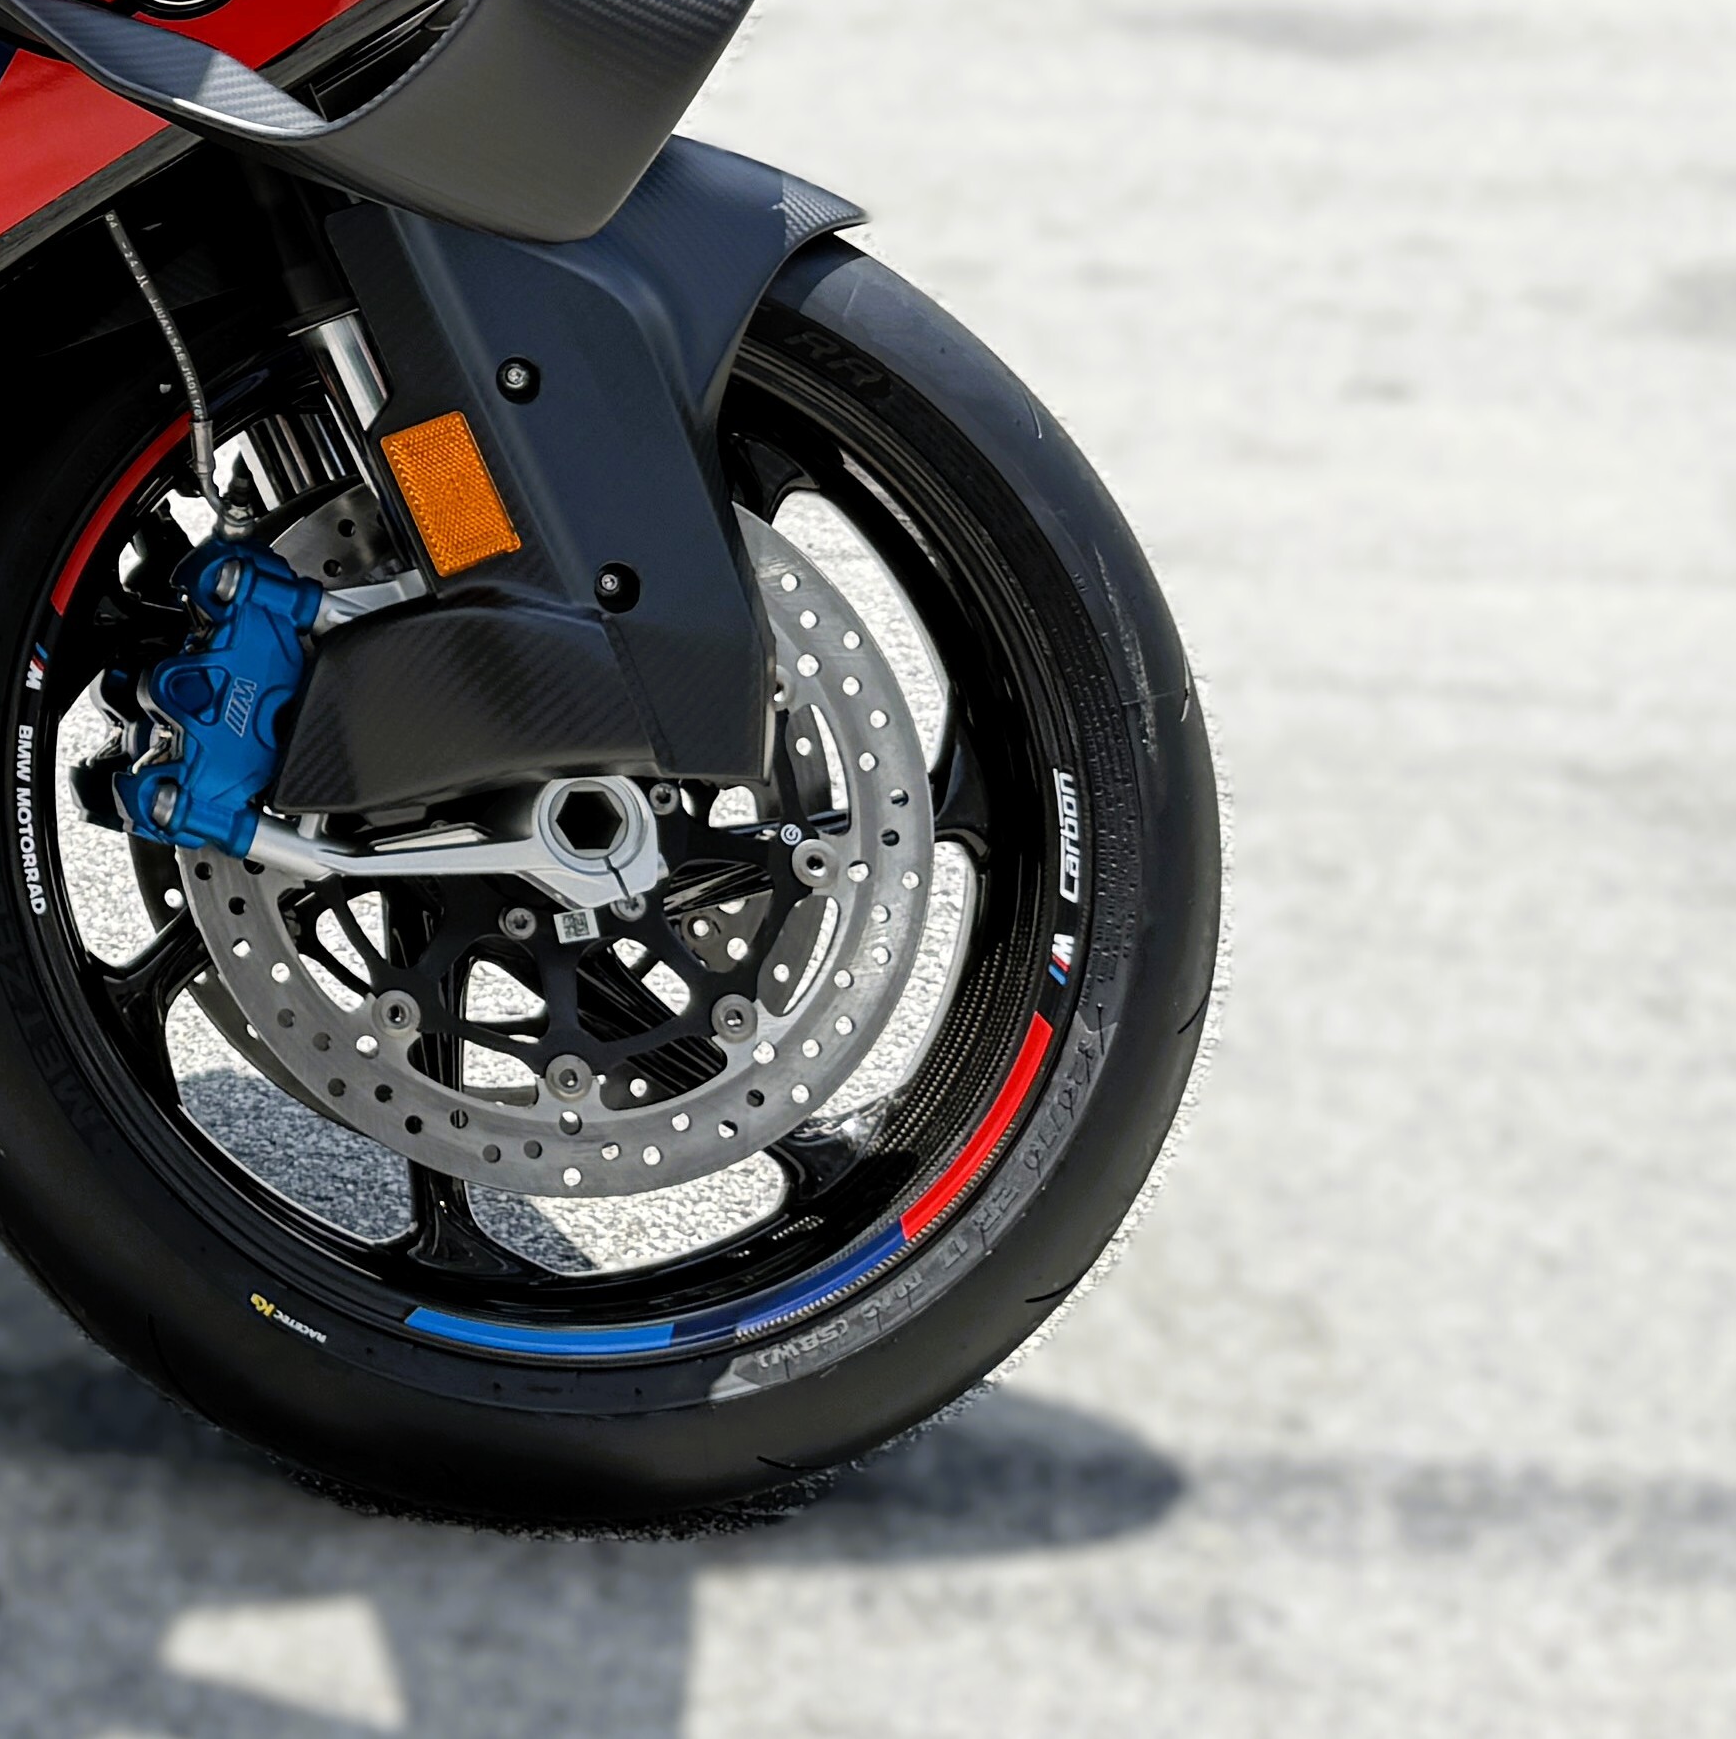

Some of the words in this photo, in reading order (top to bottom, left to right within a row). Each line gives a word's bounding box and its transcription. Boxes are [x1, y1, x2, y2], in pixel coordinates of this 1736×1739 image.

[16, 724, 34, 782] BMW
[16, 787, 47, 915] MOTORRAD
[1052, 767, 1080, 904] Carbon
